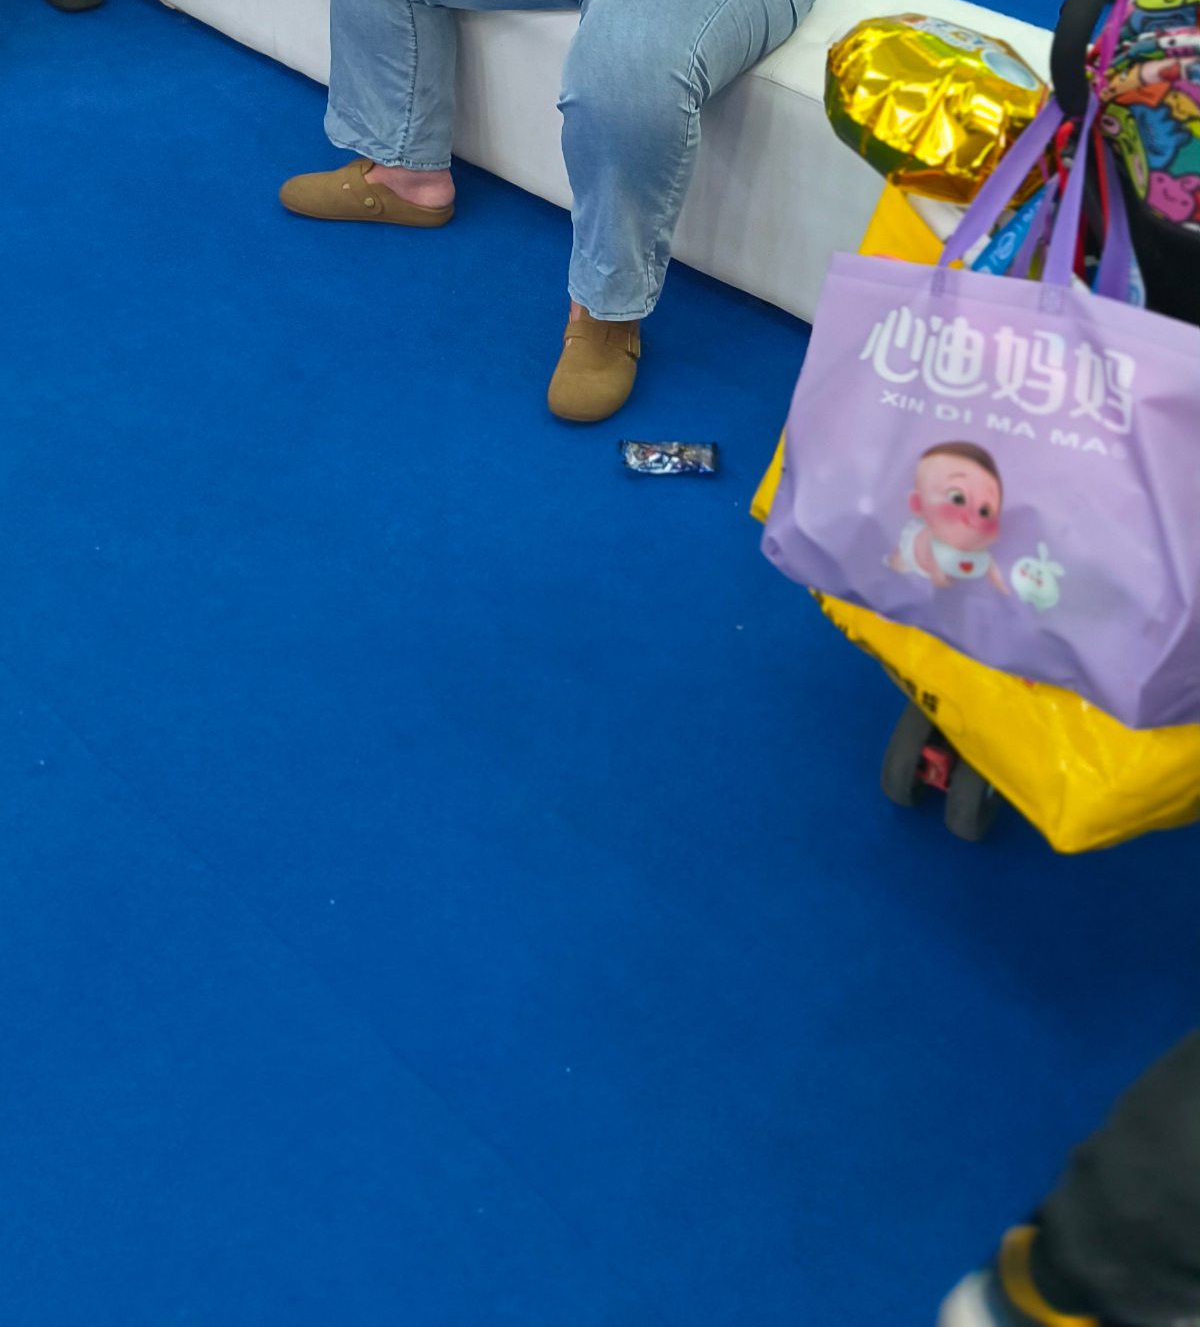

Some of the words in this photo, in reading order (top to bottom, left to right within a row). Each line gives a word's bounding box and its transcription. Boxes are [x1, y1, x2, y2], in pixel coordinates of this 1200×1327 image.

[859, 305, 1137, 434] 心迪妈妈
[880, 389, 925, 414] XIN
[935, 403, 972, 424] DI
[985, 413, 1036, 439] MA
[1050, 428, 1108, 456] MA
